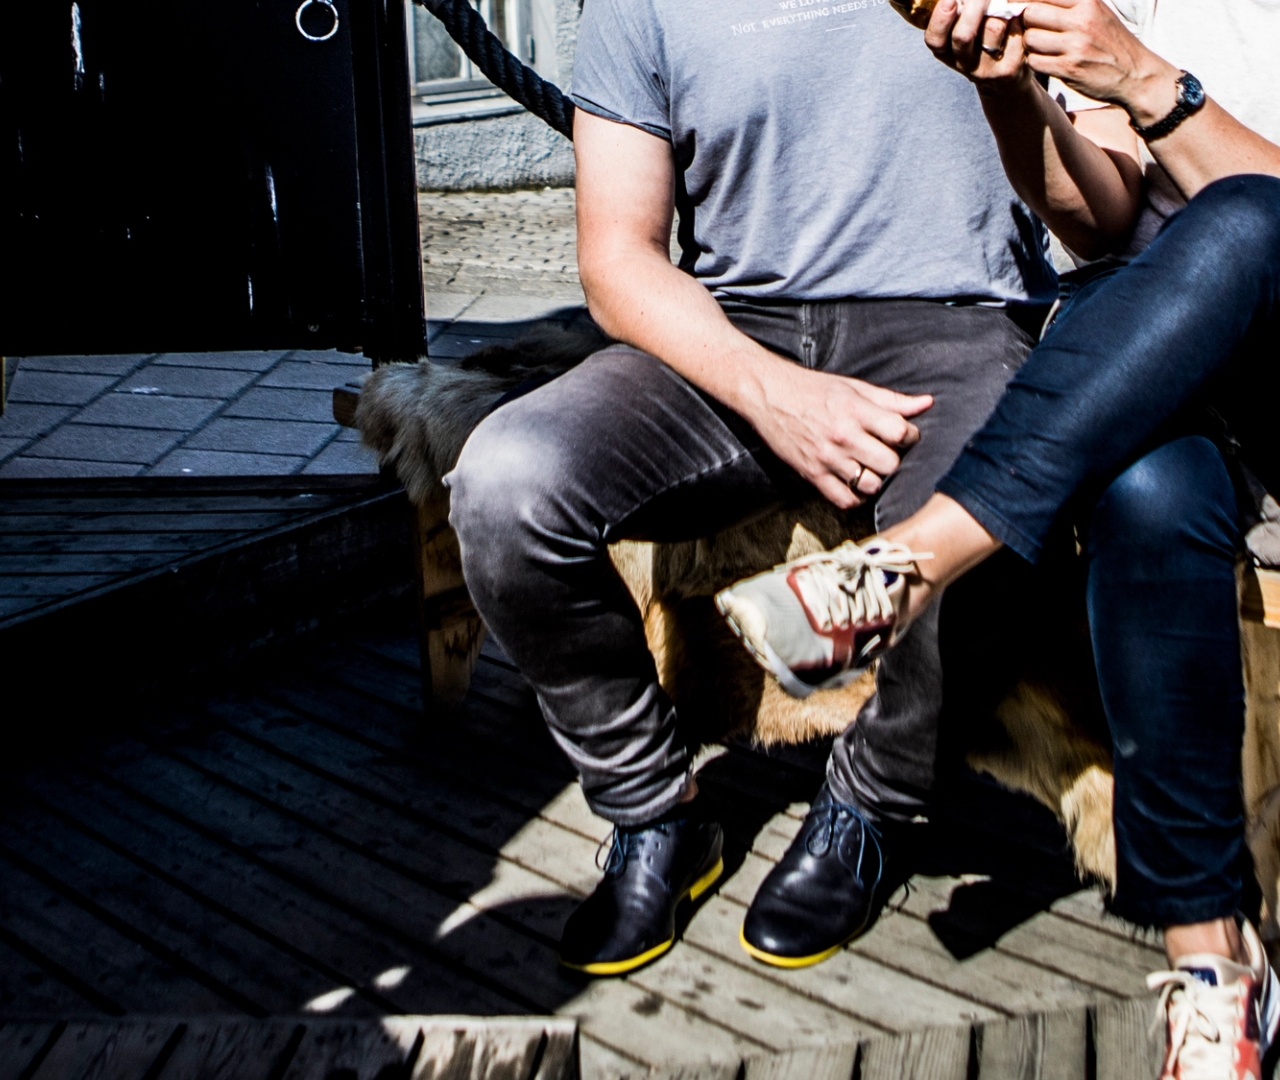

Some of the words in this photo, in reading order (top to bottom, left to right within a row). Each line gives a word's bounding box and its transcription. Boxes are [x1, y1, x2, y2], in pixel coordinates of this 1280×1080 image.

[762, 7, 830, 29] EVERYTHING
[833, 1, 869, 16] NEEDS
[778, 0, 798, 11] WE
